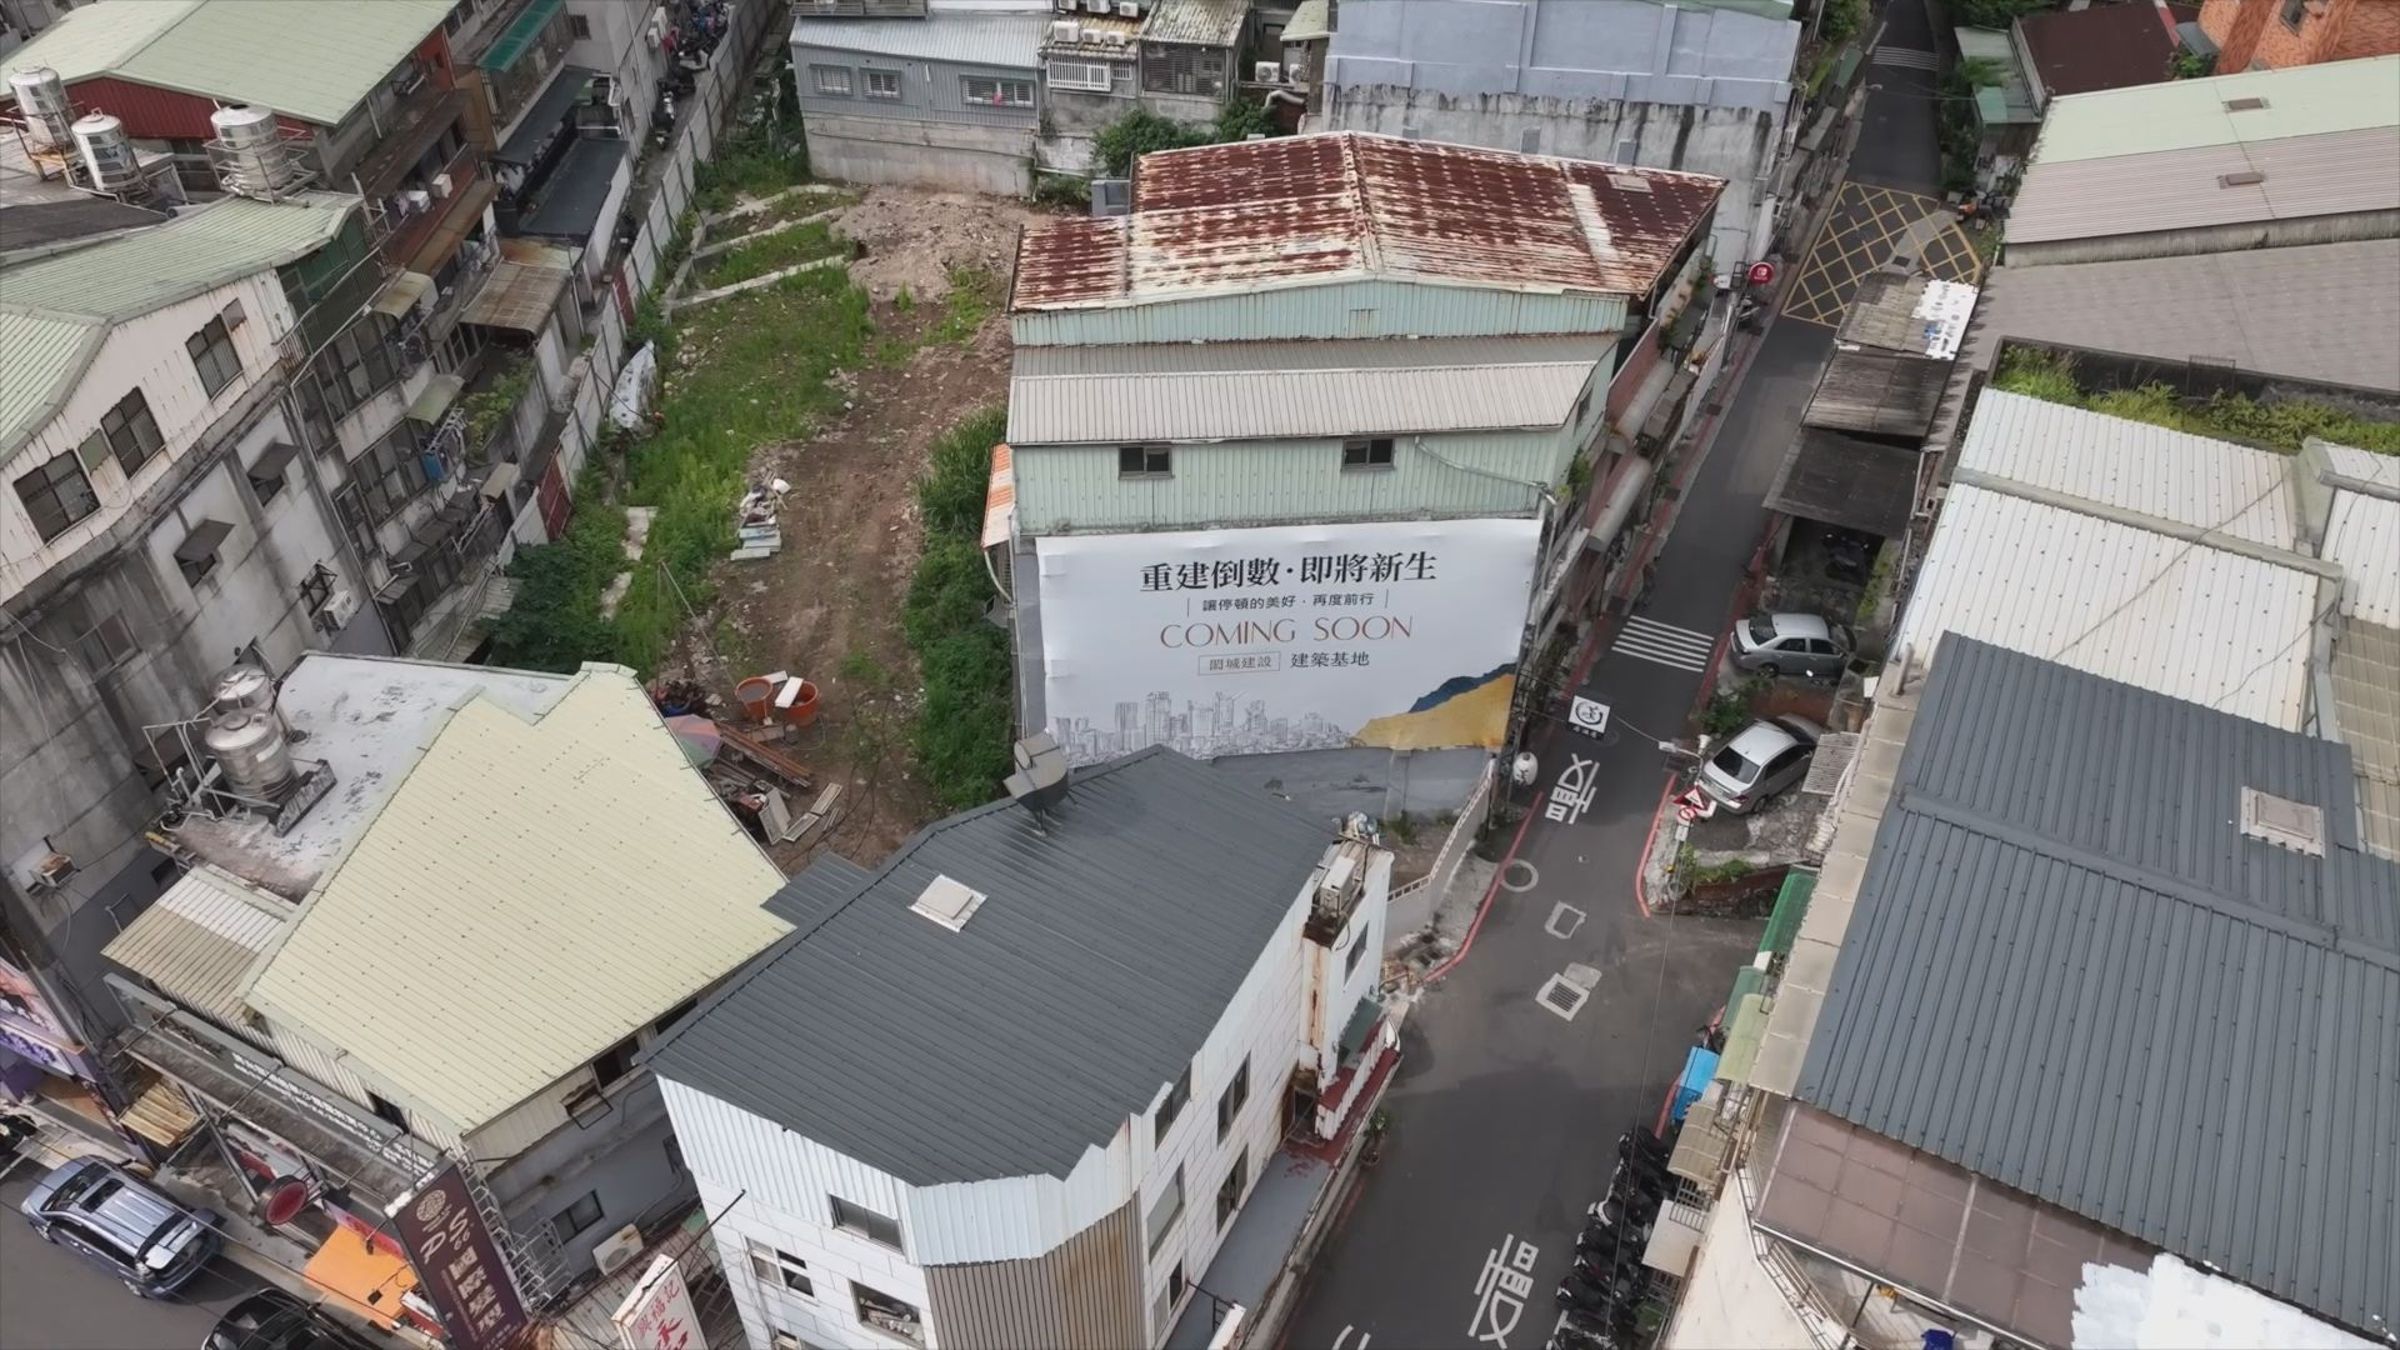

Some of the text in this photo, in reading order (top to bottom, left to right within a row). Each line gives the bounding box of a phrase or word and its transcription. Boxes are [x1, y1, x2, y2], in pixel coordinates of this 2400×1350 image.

[1160, 615, 1414, 648] COMING SOON
[1289, 651, 1370, 667] 建築基地
[1545, 753, 1600, 825] 慢
[1468, 1233, 1539, 1349] 慢
